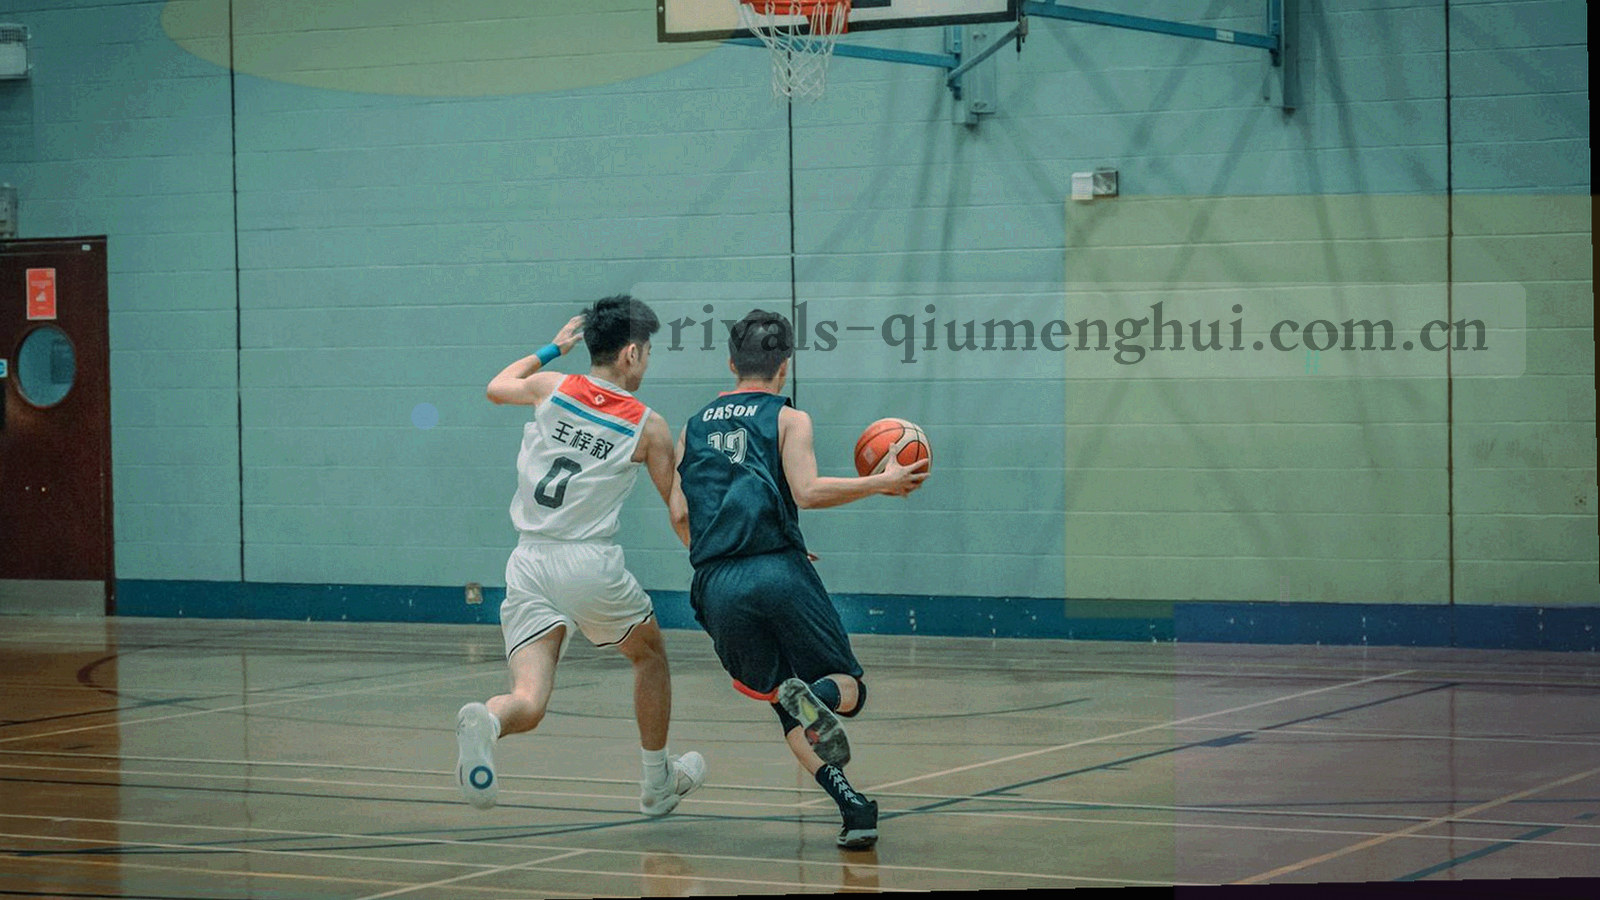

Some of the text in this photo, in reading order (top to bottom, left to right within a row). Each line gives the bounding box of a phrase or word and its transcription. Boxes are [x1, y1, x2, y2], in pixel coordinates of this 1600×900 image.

[702, 404, 758, 422] CASON
[551, 420, 615, 460] 王梓叙
[534, 456, 582, 509] 0
